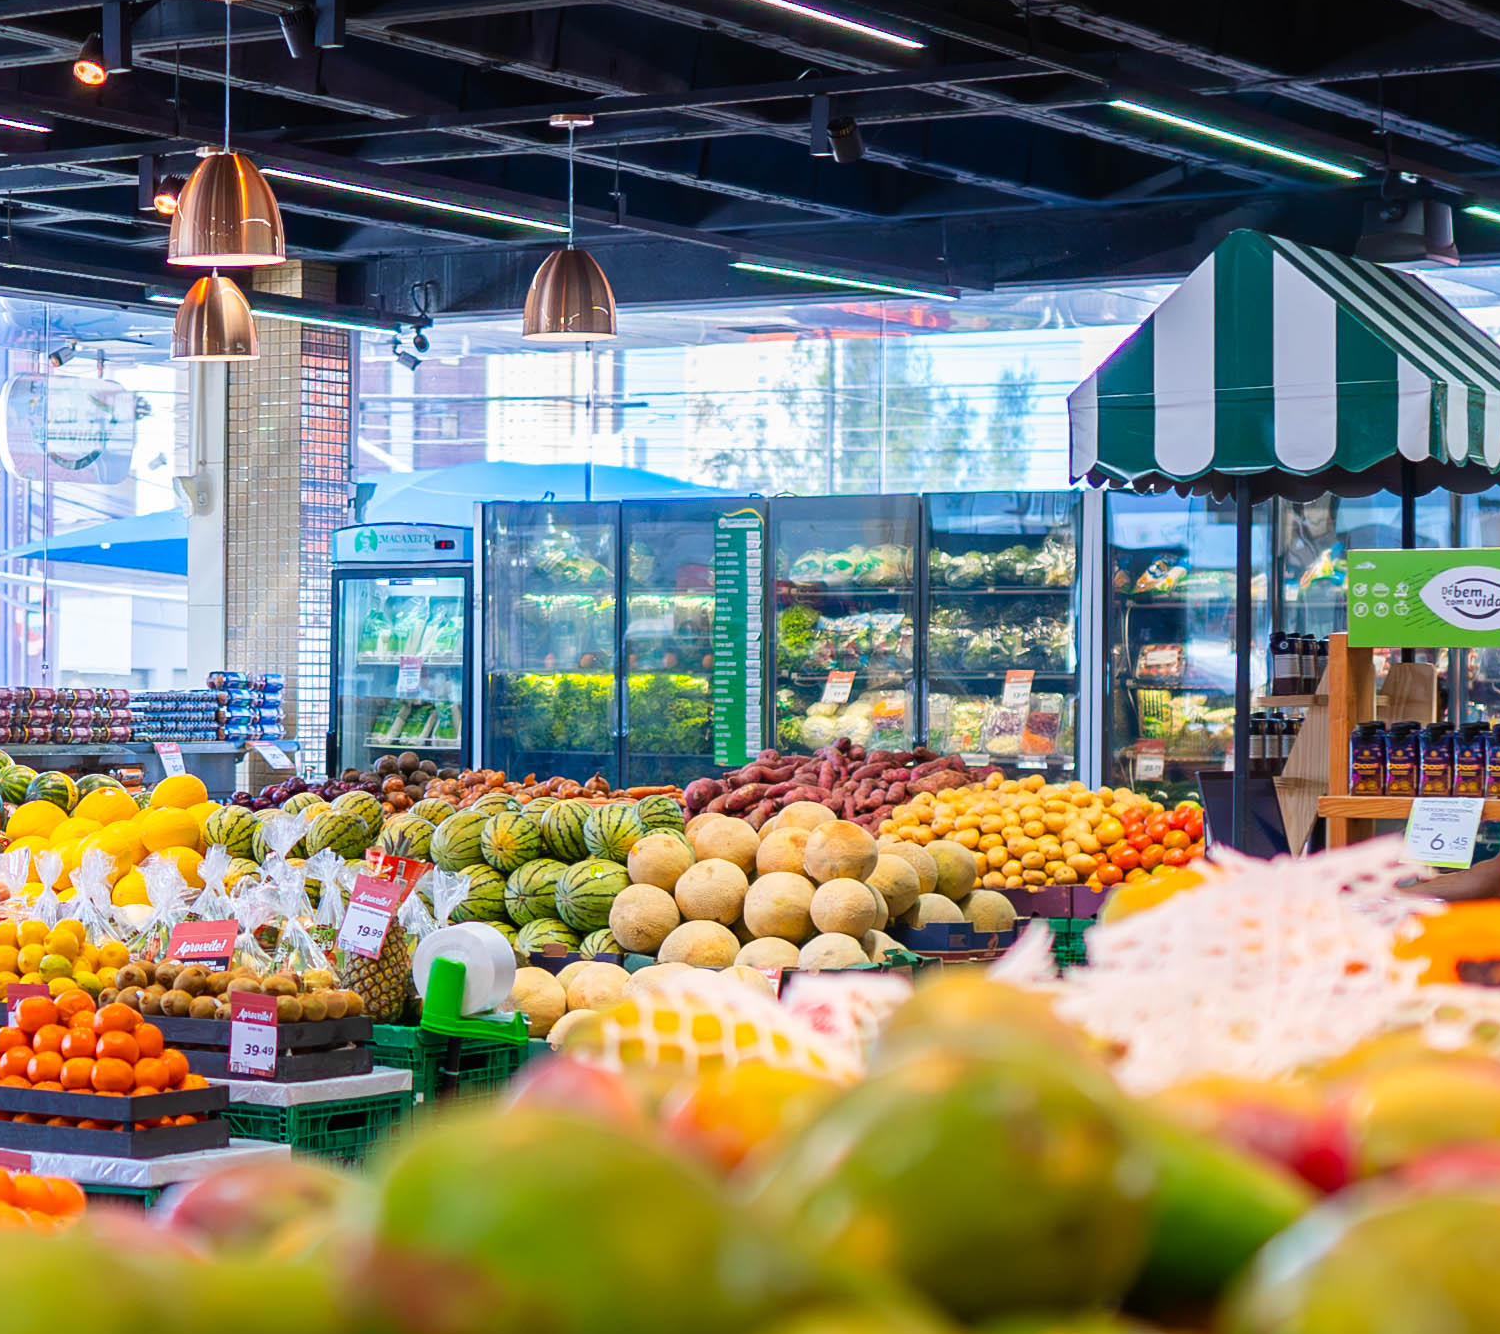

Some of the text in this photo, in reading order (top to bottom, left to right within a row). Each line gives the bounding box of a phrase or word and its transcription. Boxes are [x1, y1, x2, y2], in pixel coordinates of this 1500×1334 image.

[1454, 585, 1483, 598] bem
[1430, 833, 1445, 851] 6
[355, 890, 392, 907] Aproveite!
[173, 938, 227, 957] Aproveite!
[235, 1007, 273, 1023] Aproveite!
[243, 1043, 274, 1057] 39.49
